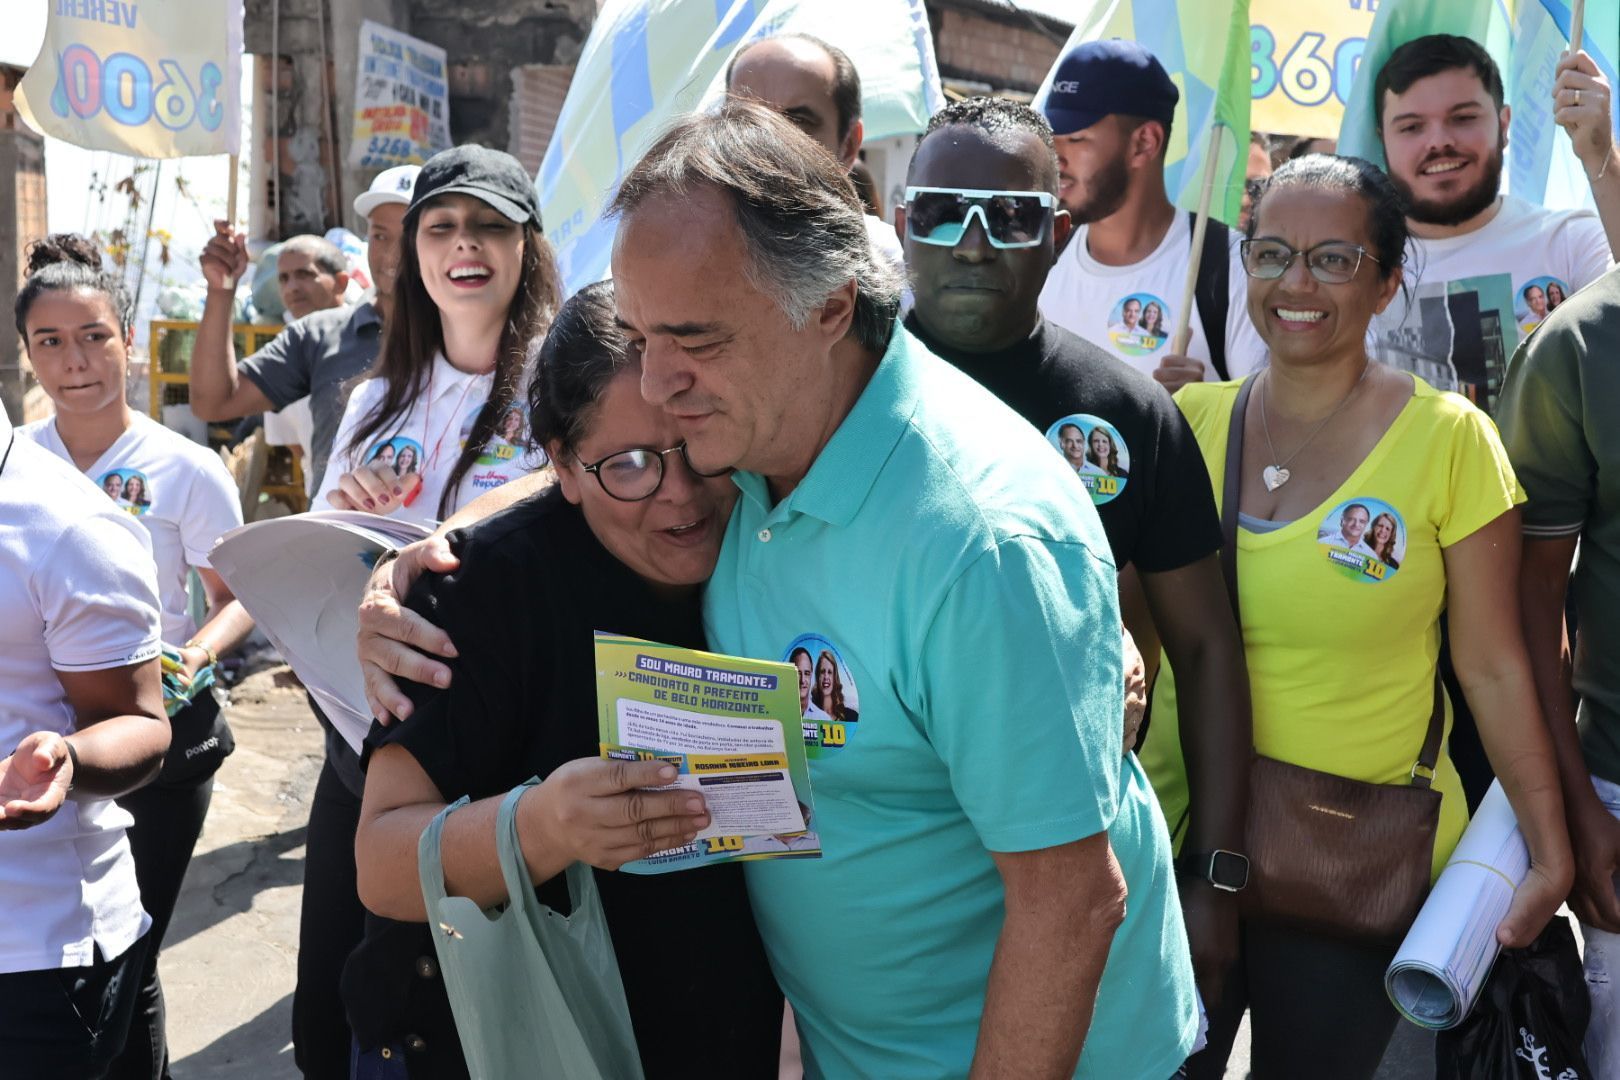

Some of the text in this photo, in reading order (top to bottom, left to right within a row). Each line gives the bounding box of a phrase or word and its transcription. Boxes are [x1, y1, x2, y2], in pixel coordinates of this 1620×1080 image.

[1097, 477, 1117, 495] 10
[1366, 560, 1386, 580] 10
[640, 657, 773, 689] SOU MAURO TRAMONTE,
[628, 672, 759, 702] CANDIDATO A PREFEITO
[654, 689, 668, 701] DE
[671, 692, 698, 707] BELO
[821, 723, 847, 747] 10
[702, 836, 744, 855] 10
